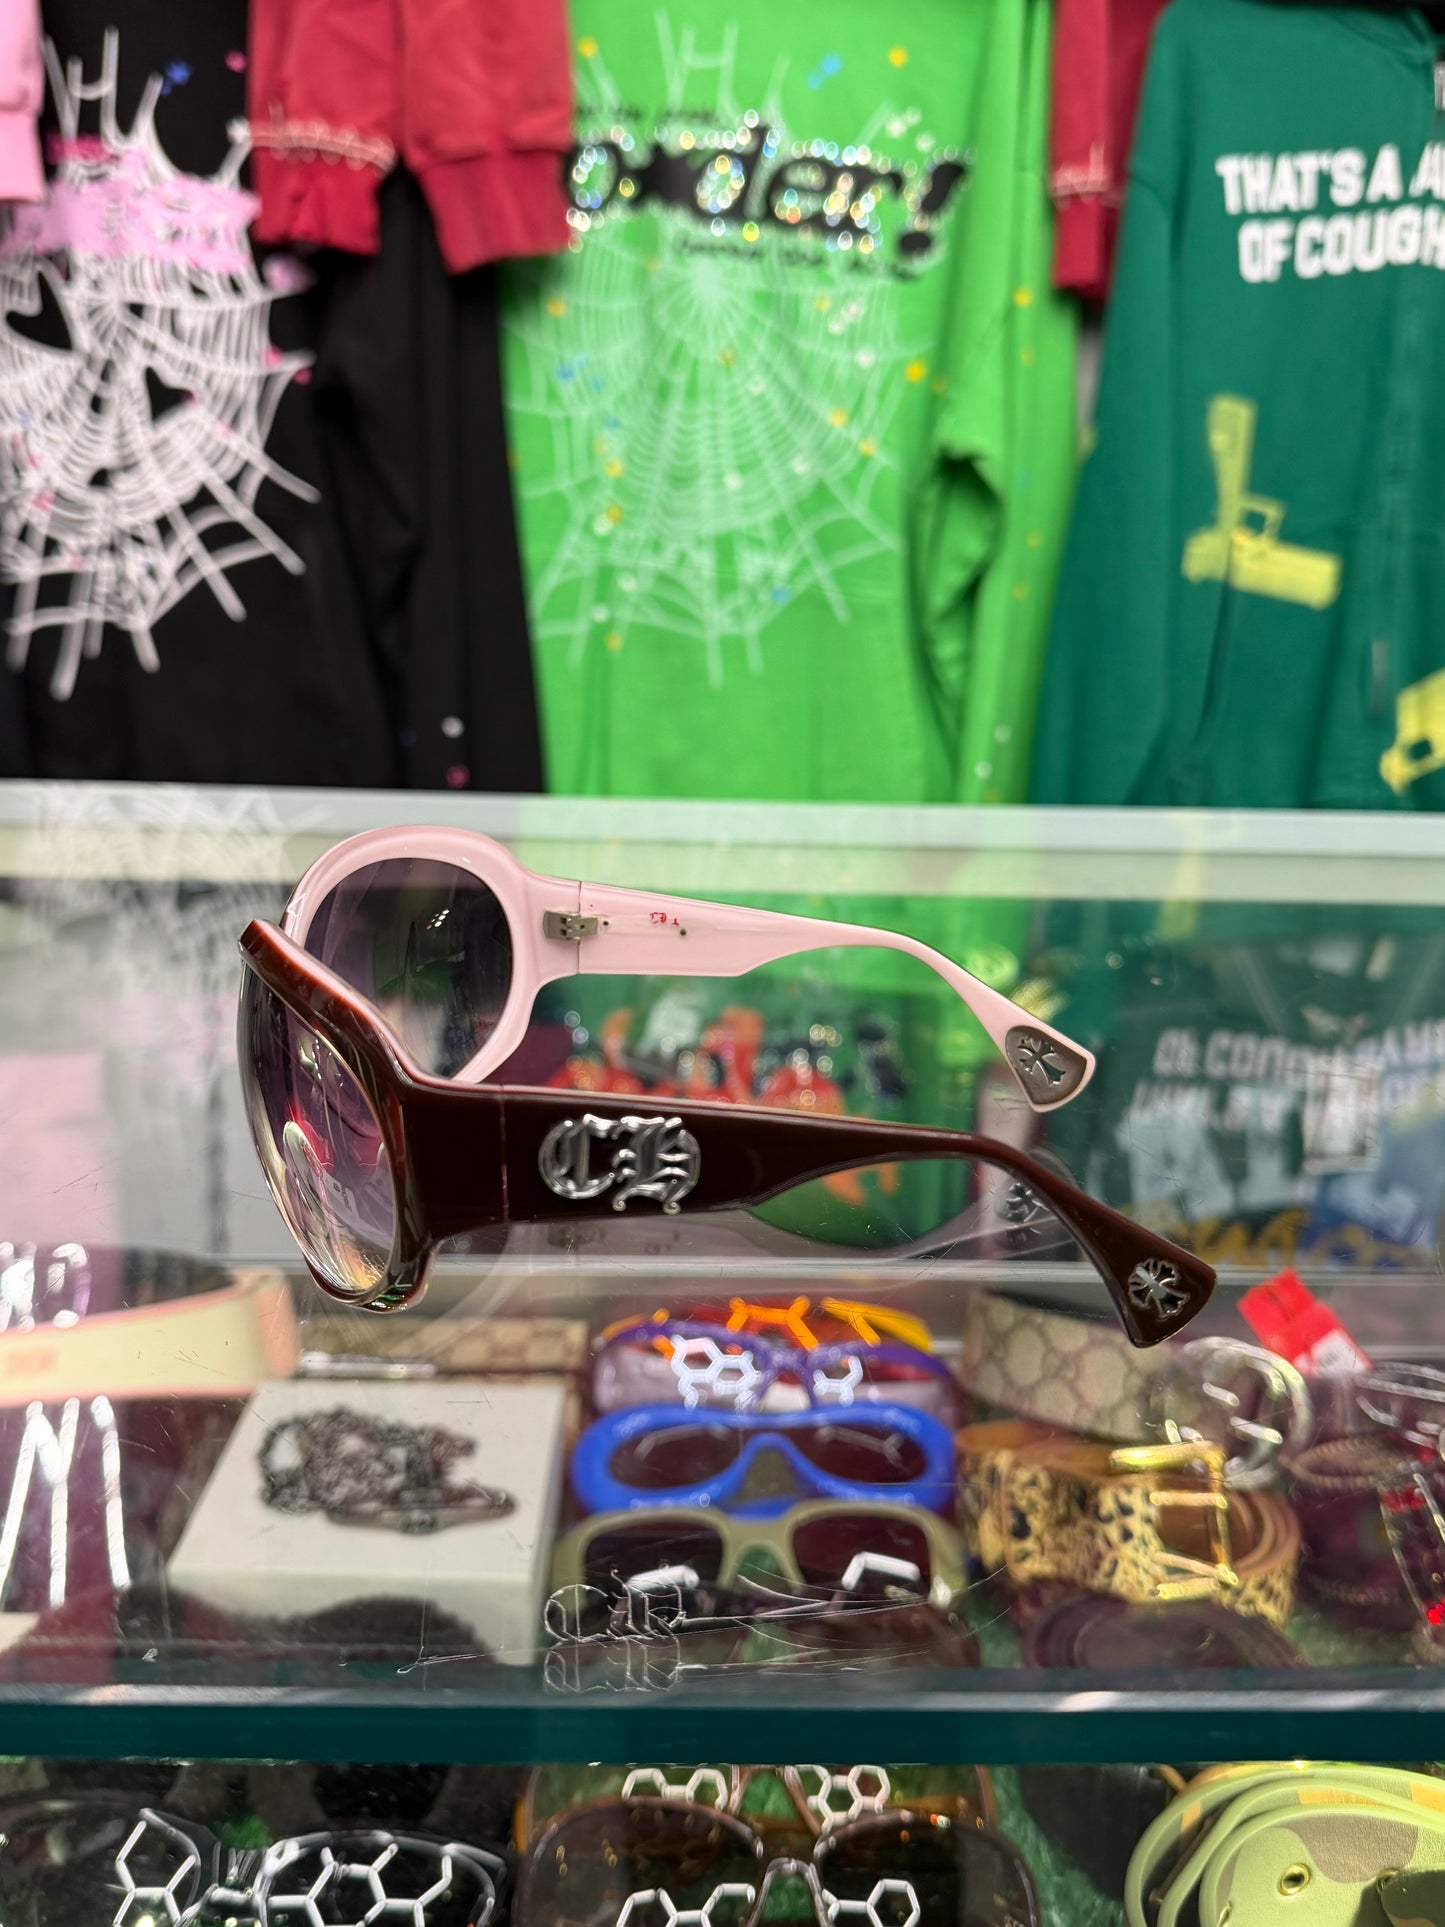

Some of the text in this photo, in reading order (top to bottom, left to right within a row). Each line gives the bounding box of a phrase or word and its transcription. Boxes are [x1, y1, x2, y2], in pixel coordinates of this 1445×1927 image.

[1215, 147, 1366, 215] THAT'S
[1366, 141, 1404, 203] A
[1238, 217, 1294, 284] OF
